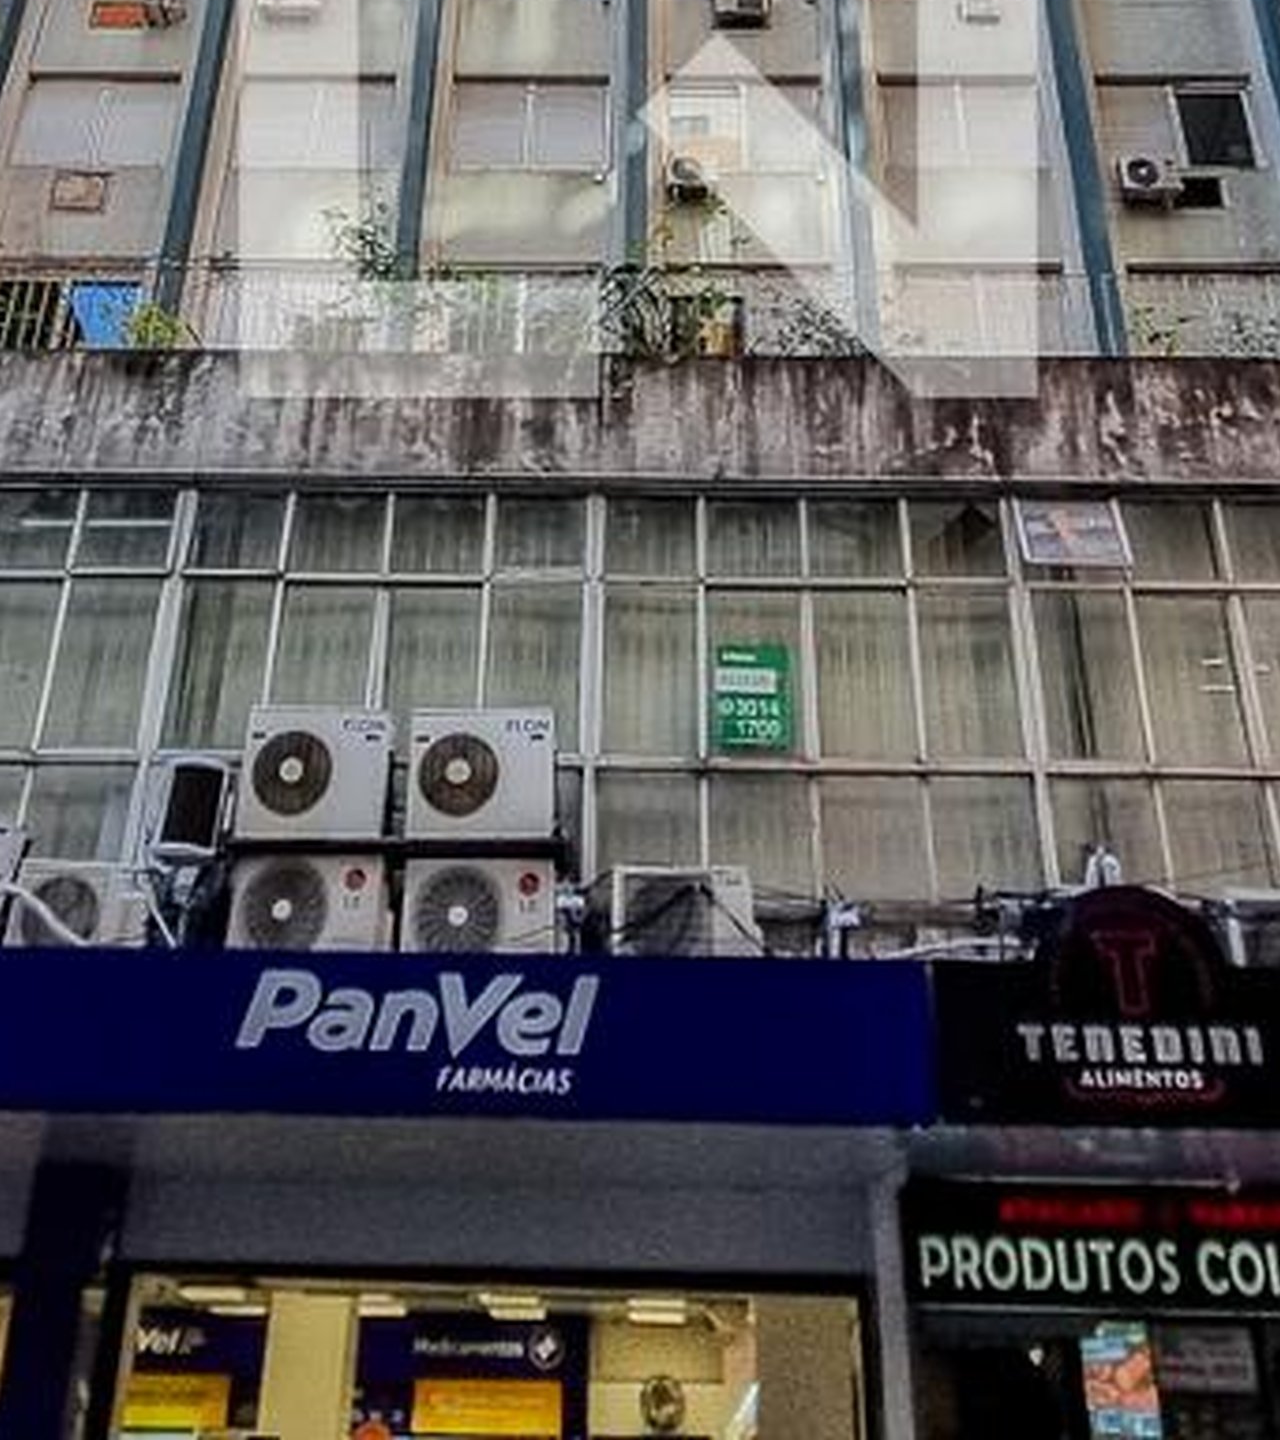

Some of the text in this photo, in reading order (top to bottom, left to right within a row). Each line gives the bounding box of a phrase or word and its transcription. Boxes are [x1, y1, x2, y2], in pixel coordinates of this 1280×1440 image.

[235, 968, 600, 1057] PanVel
[435, 1061, 572, 1097] FARMÁCIAS
[1079, 1068, 1205, 1091] ALIMENTOS
[919, 1234, 1181, 1296] PRODUTOS
